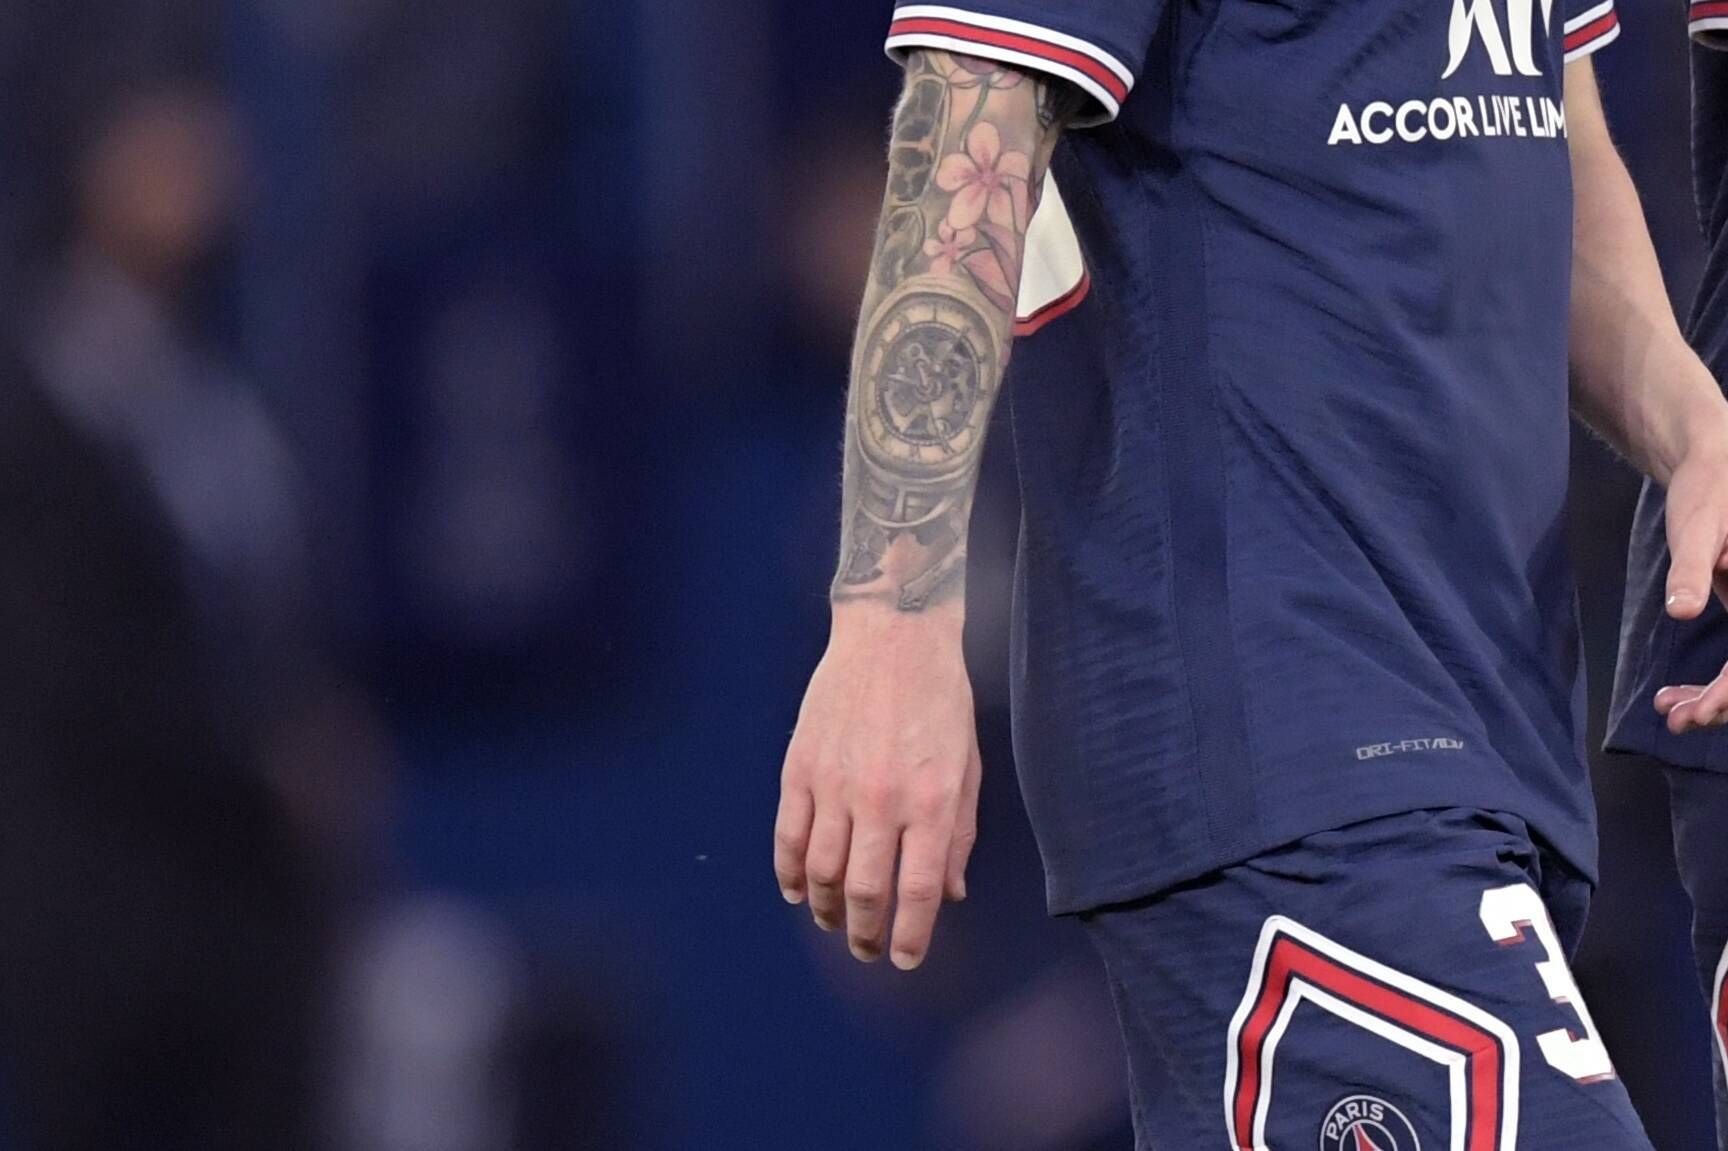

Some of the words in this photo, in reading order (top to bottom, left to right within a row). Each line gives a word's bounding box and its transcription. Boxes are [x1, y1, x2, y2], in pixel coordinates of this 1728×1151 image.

[1327, 96, 1479, 145] ACCOR
[1477, 94, 1527, 137] LIVE
[1325, 1100, 1385, 1141] PARIS
